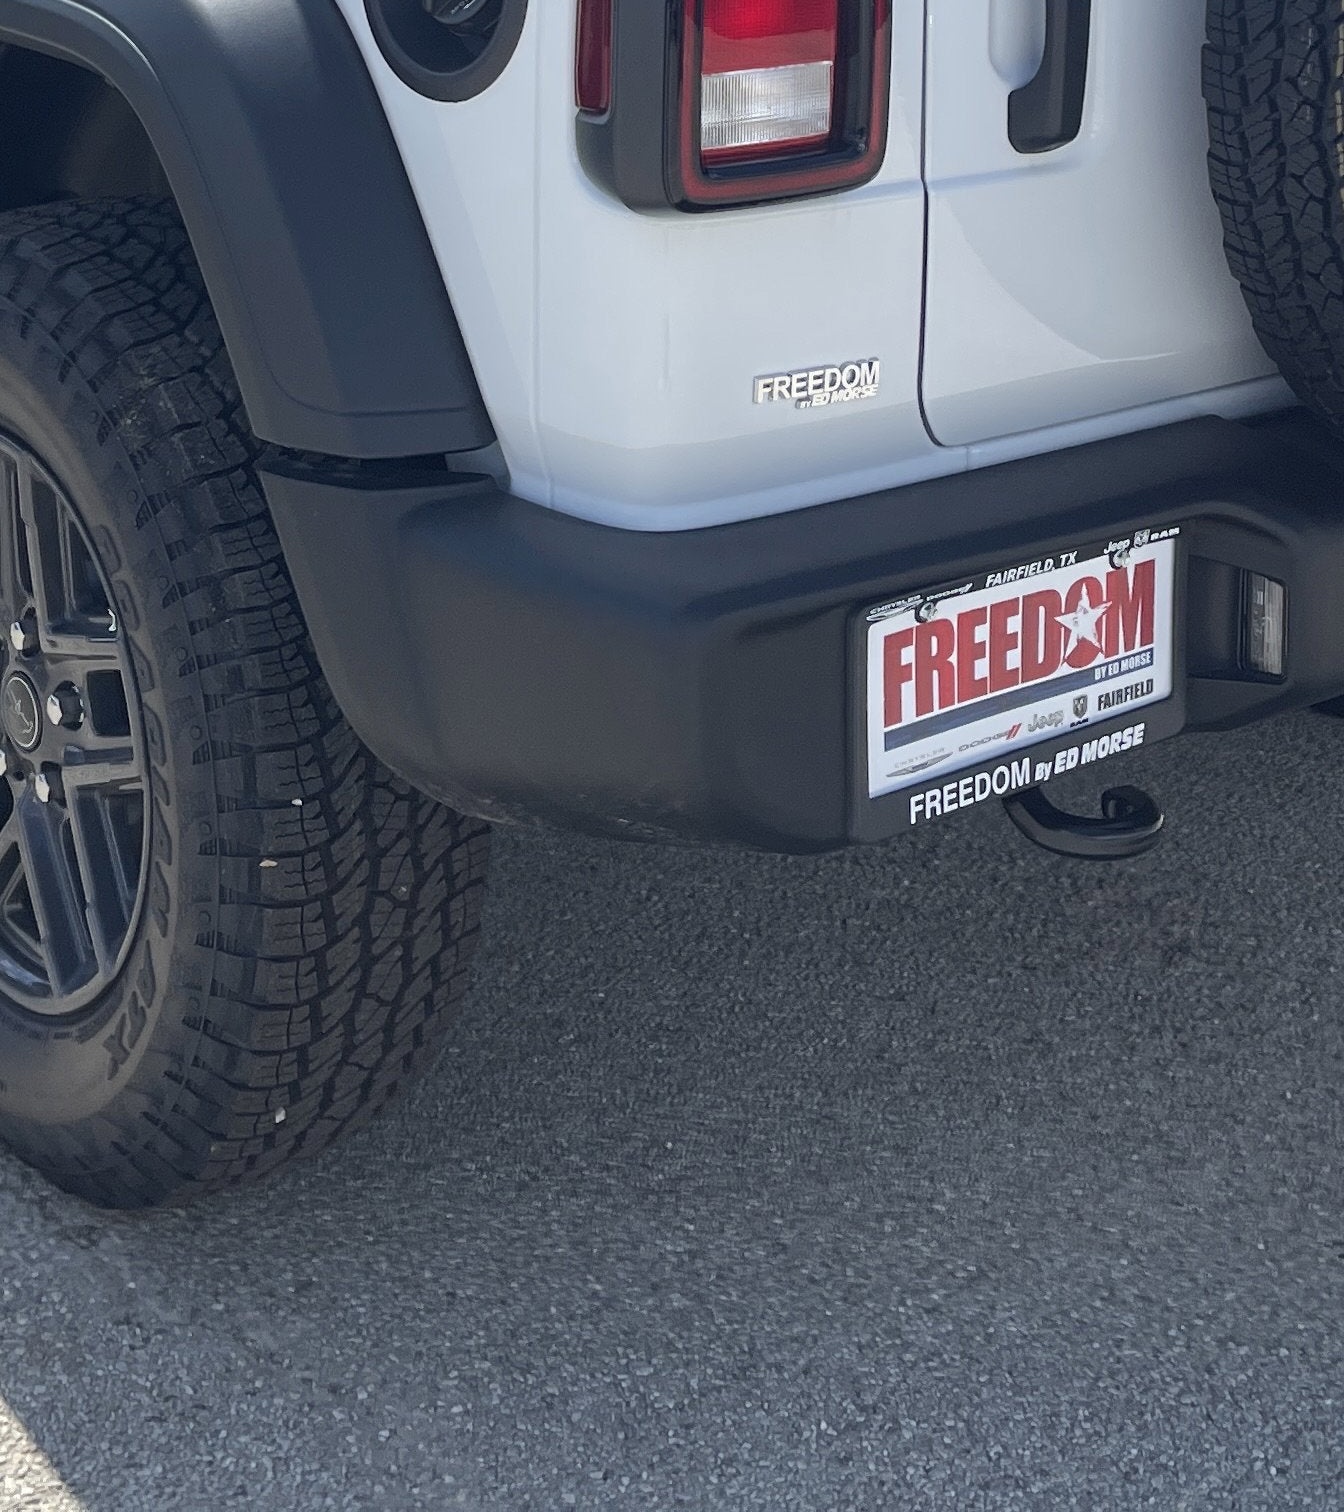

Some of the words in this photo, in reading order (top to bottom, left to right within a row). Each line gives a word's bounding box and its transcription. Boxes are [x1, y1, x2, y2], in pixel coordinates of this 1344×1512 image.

[753, 357, 880, 404] FREEDOM
[811, 391, 830, 407] ED
[831, 383, 879, 403] MORSE
[985, 557, 1056, 588] FAIRFIELD,
[1059, 551, 1078, 569] TX
[883, 558, 1156, 729] FREEDOM
[1094, 667, 1106, 681] BY
[1107, 660, 1119, 678] ED
[1120, 651, 1152, 674] MORSE
[1097, 678, 1154, 712] FAIRFIELD
[1027, 709, 1065, 733] Jeep
[909, 756, 1031, 825] FREEDOM
[1054, 747, 1079, 775] ED
[1080, 722, 1146, 765] MORSE
